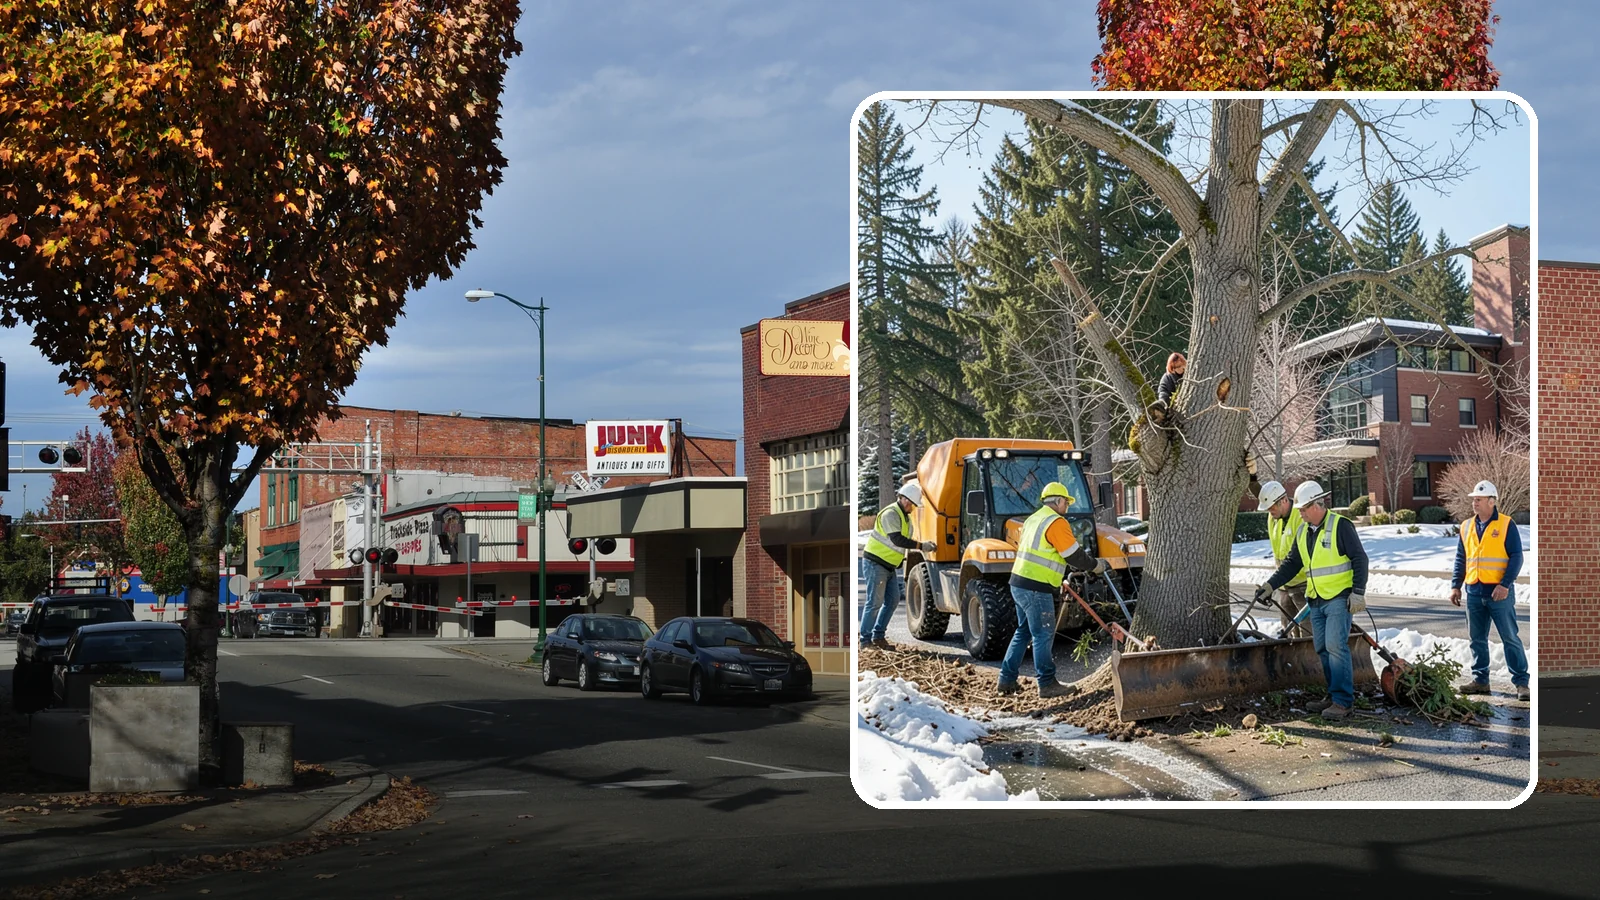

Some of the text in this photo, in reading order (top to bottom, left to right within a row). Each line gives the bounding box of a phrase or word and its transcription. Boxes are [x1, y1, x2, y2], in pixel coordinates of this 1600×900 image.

[765, 327, 831, 365] Decor
[596, 425, 665, 457] JUNK
[596, 461, 665, 470] ANTIQUES AND GIFTS
